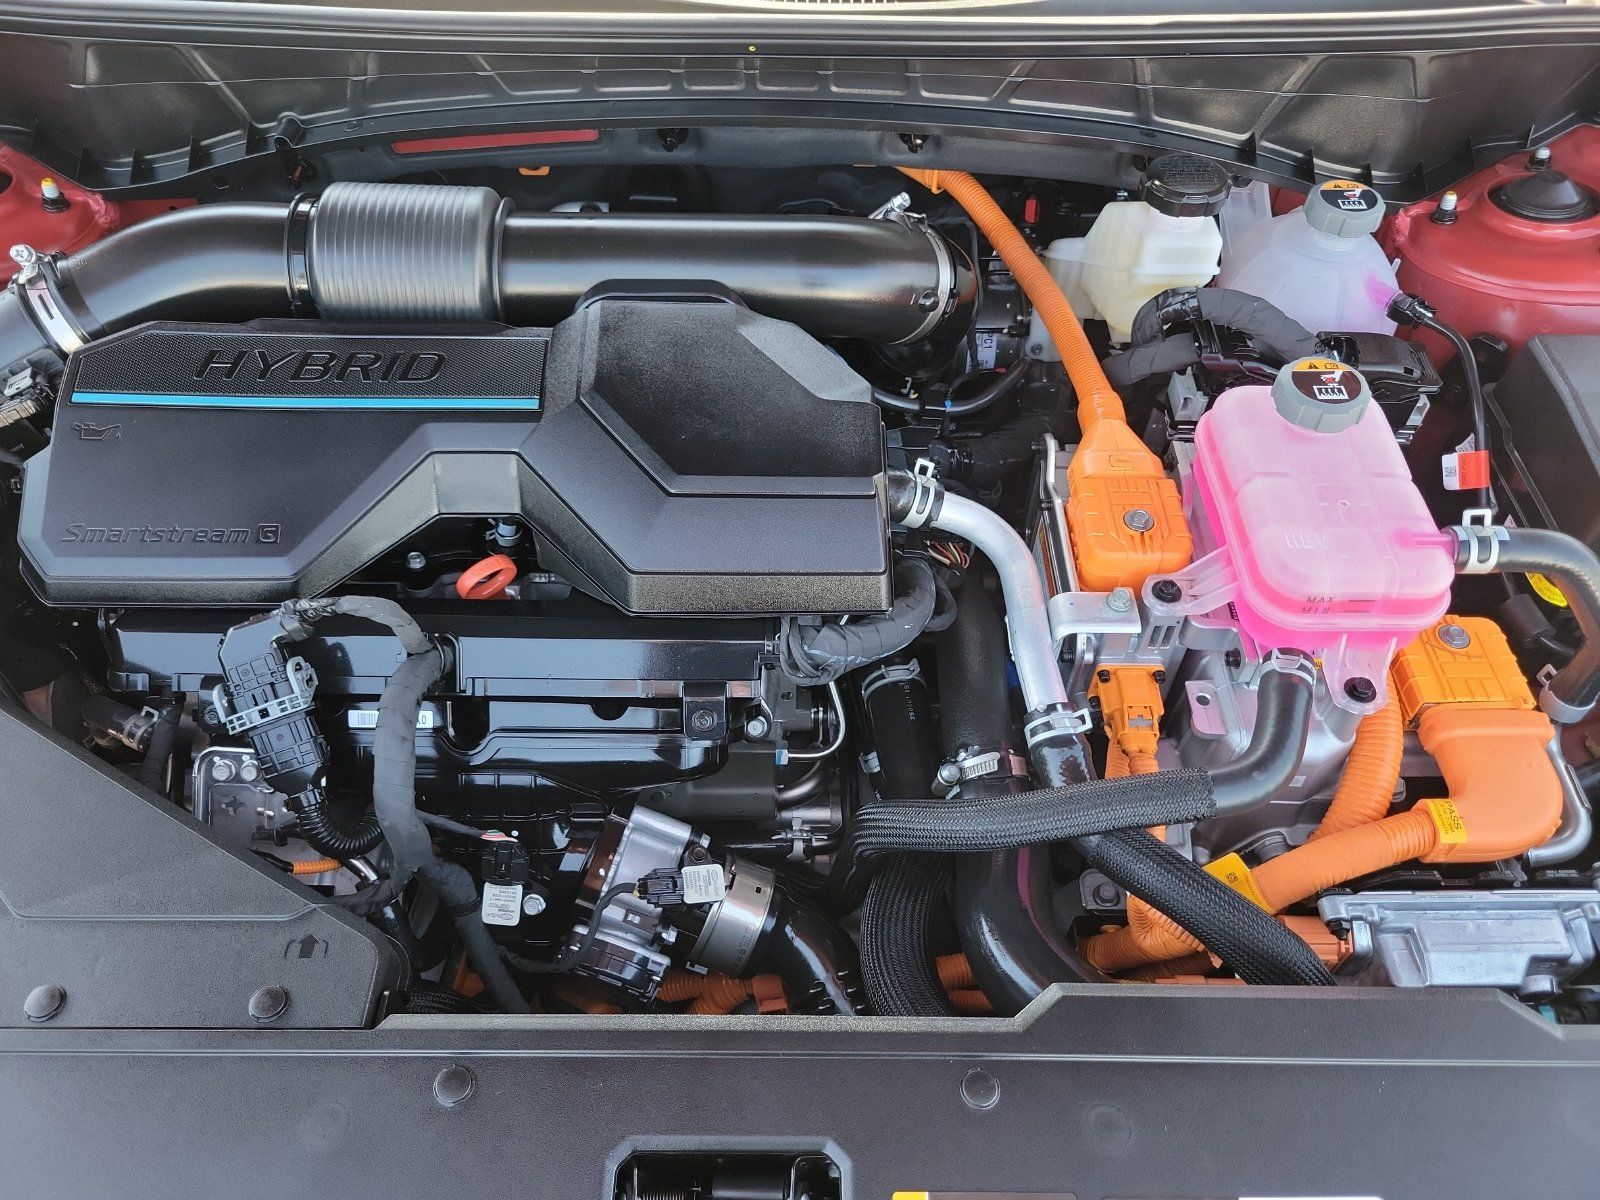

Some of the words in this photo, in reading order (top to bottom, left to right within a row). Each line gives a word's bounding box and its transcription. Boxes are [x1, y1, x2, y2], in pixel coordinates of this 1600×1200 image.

[193, 349, 447, 383] HYBRID
[62, 523, 251, 543] Smartstream
[258, 524, 280, 543] G
[1444, 801, 1462, 830] PASS
